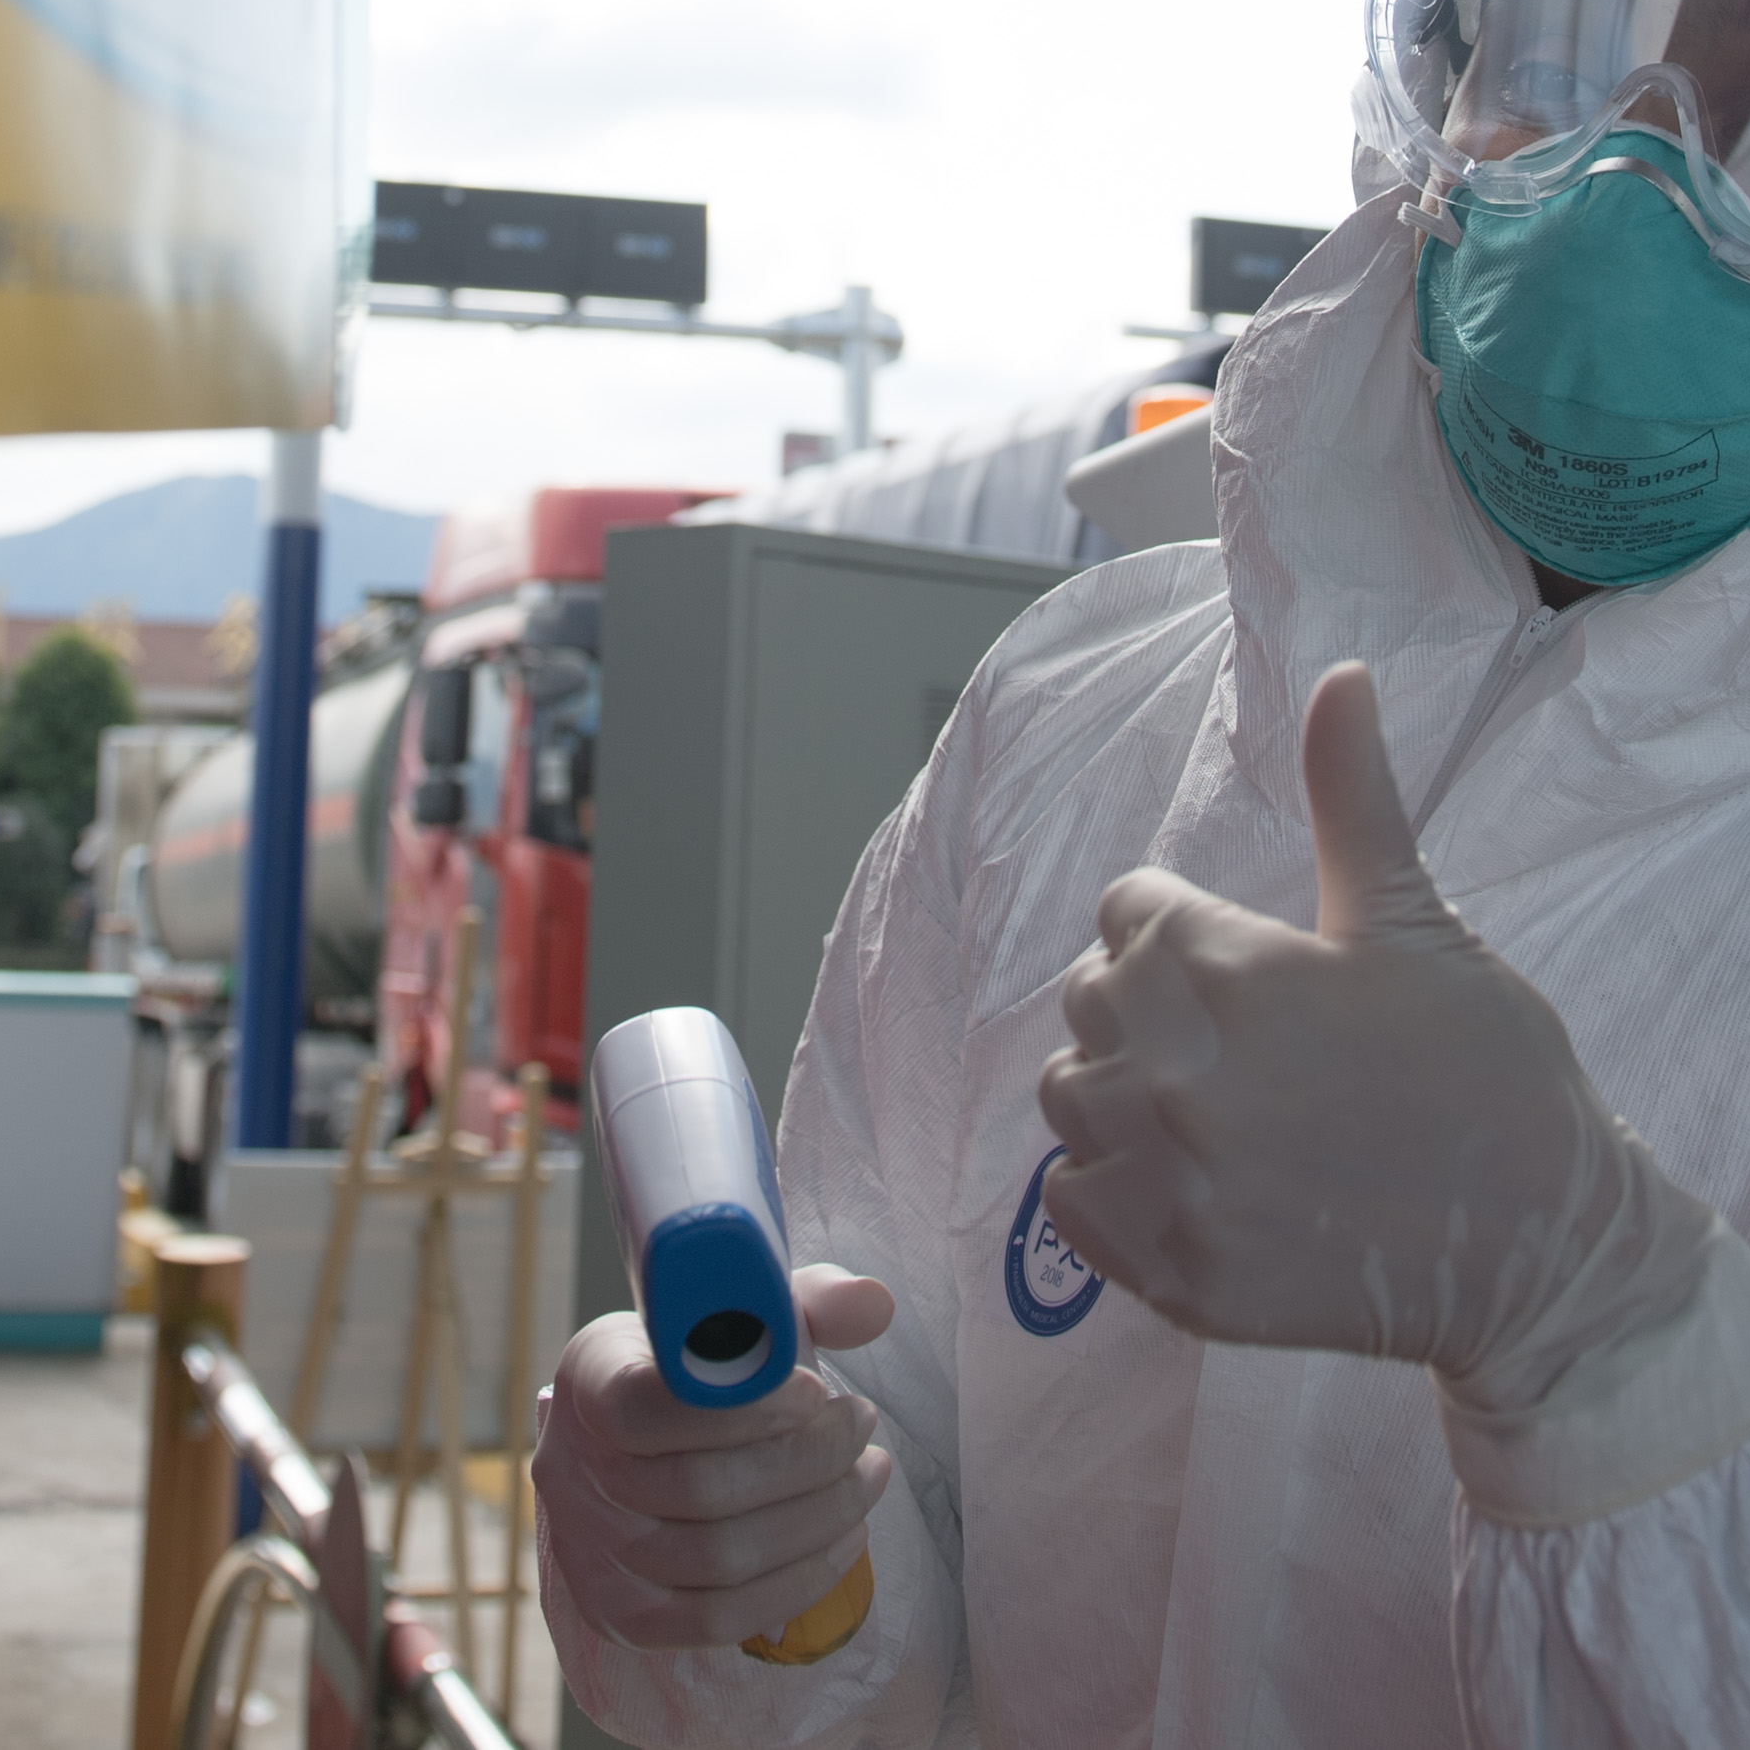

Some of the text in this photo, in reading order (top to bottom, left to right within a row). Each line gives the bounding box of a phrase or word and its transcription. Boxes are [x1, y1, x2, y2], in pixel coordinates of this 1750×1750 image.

[1464, 392, 1495, 444] NIOSH
[1508, 427, 1629, 476] 3M 1860S
[1521, 467, 1611, 500] TC-84A-0006
[1525, 456, 1559, 480] N95
[1598, 458, 1708, 489] LOT B19794
[1517, 479, 1608, 513] PARTICULATE
[1612, 488, 1705, 513] RESPIRATOR
[1521, 493, 1592, 520] SURGICAL
[1596, 513, 1639, 523] MASK
[1578, 529, 1604, 539] with
[1606, 530, 1627, 539] the
[1039, 1264, 1065, 1289] 2018
[1030, 1309, 1059, 1324] MEDICAL
[1061, 1292, 1088, 1320] CENTER
